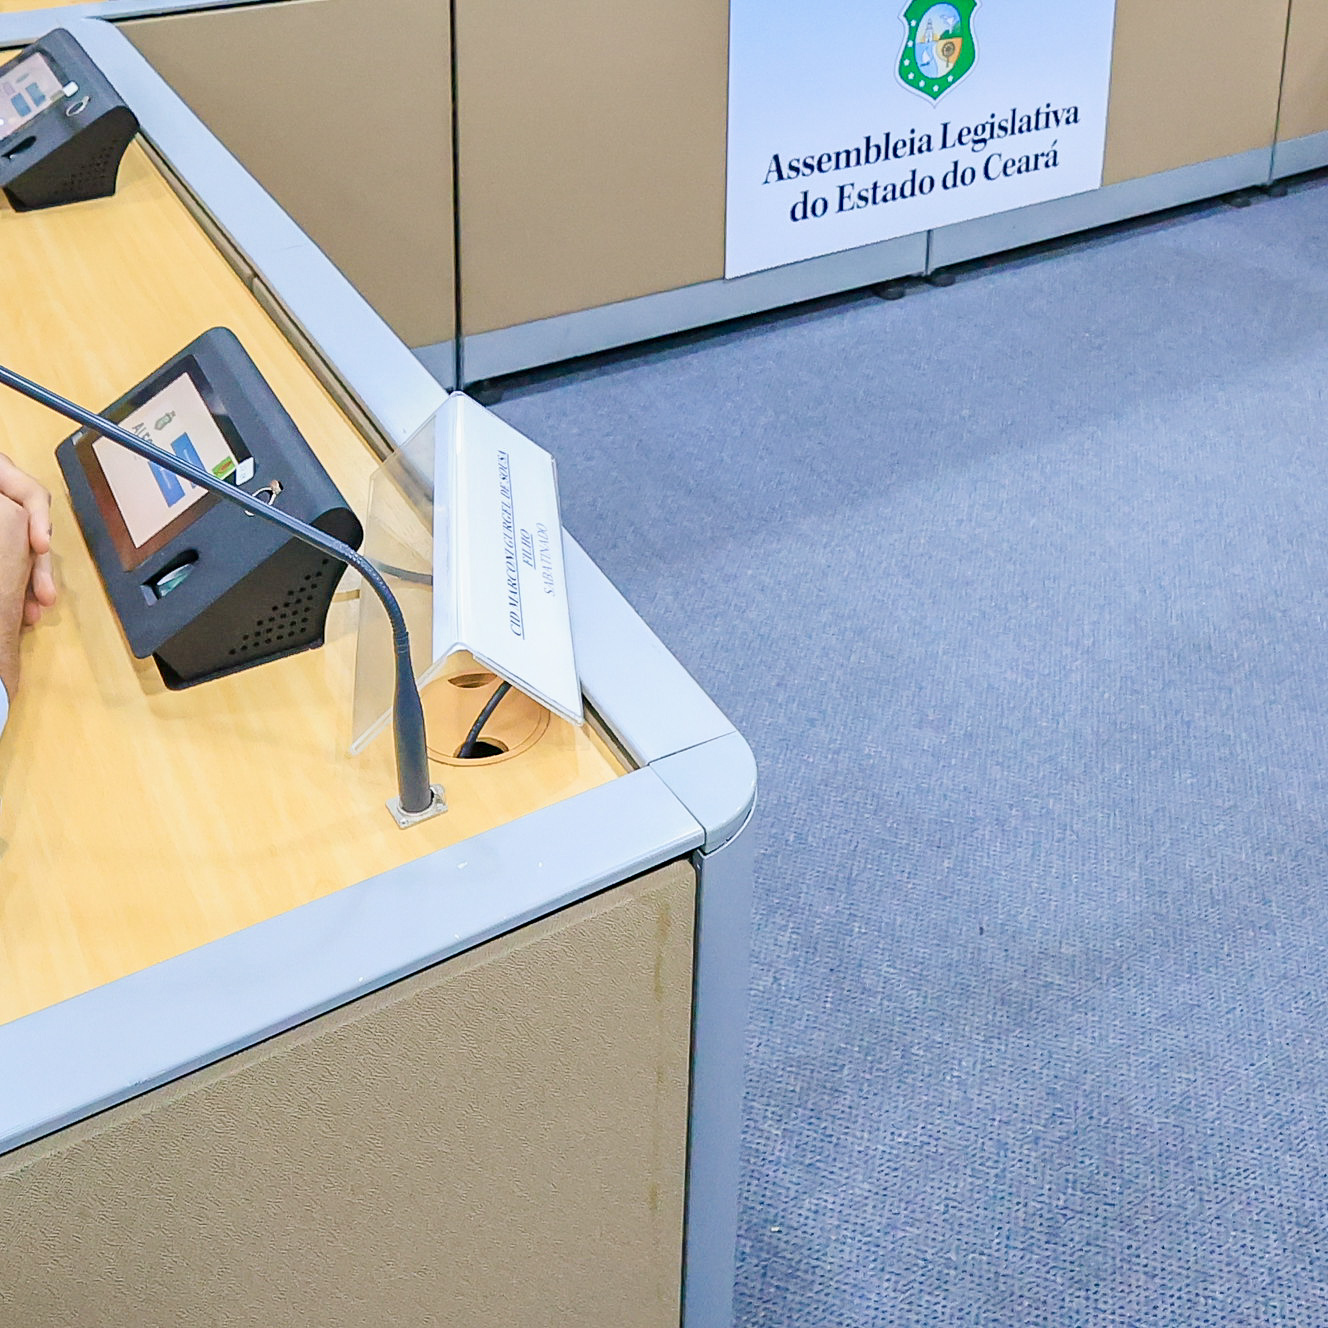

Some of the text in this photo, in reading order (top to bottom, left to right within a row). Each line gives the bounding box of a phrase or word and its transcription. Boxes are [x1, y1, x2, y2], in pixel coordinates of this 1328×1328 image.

[762, 102, 1081, 185] Assembleia Legislativa
[790, 139, 1060, 222] do Estado do Ceará
[499, 484, 511, 500] DE
[504, 548, 519, 611] MARCONI
[519, 528, 534, 568] FILHO
[536, 522, 555, 597] SABATINADO
[509, 610, 522, 637] CID
